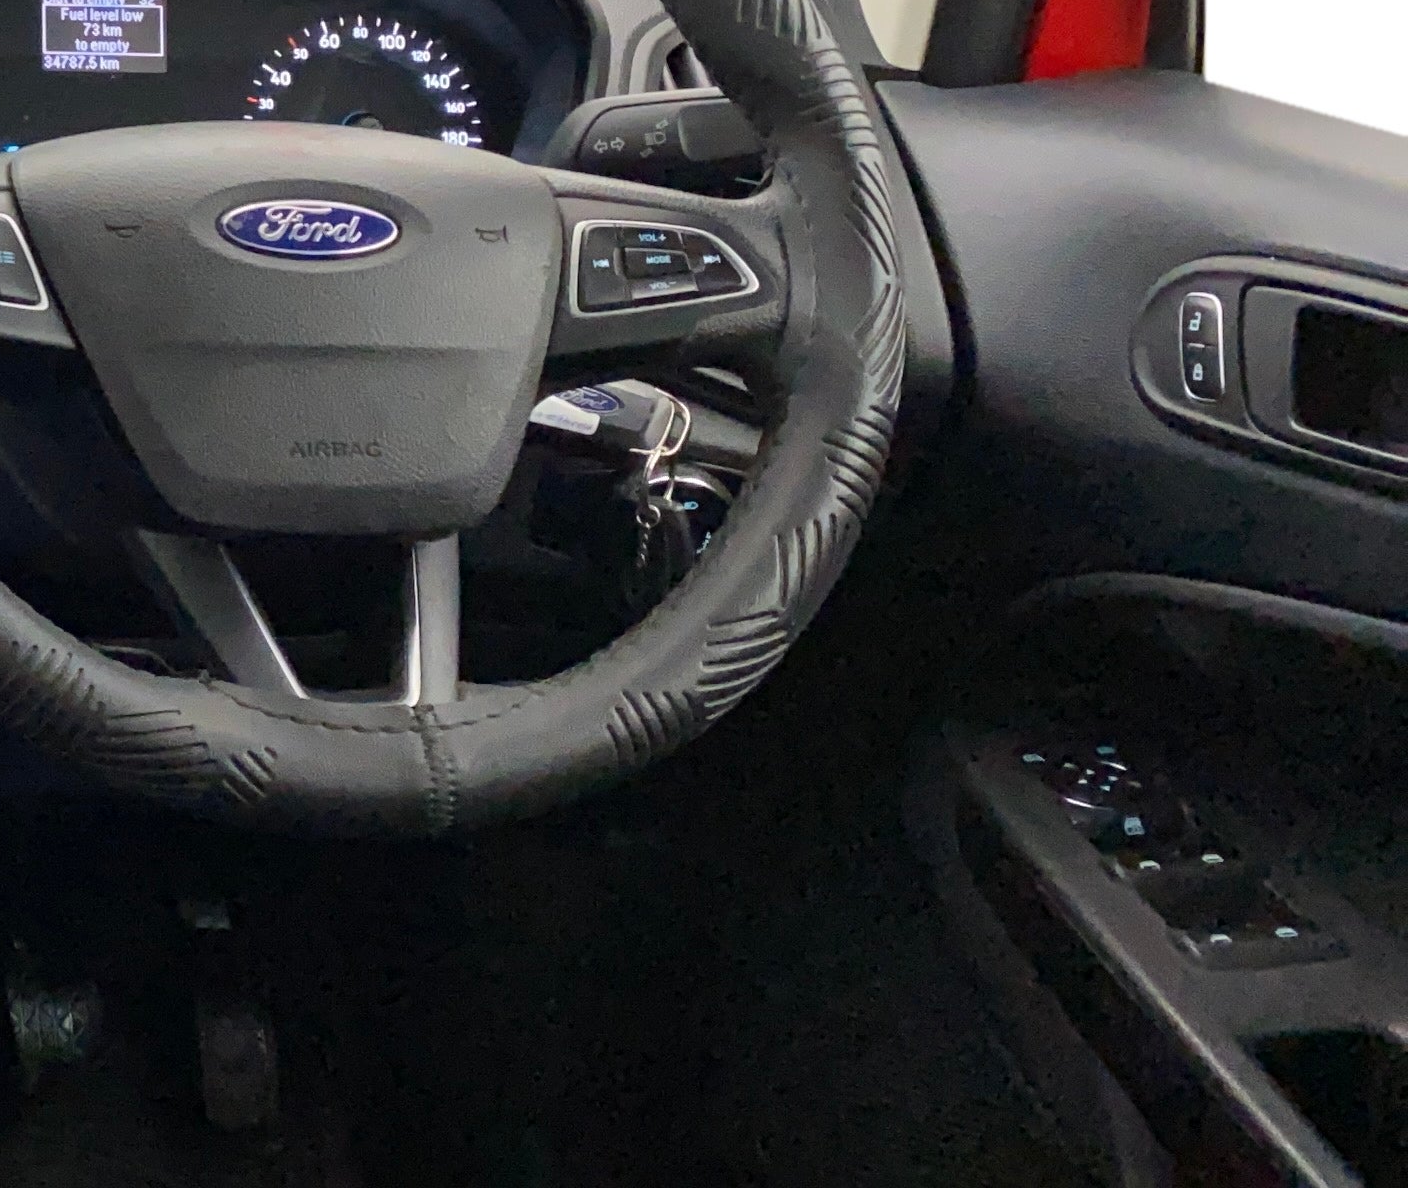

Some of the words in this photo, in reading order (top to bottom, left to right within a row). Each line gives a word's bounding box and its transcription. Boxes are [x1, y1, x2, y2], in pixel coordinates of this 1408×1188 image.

[60, 7, 87, 21] Fuel
[90, 8, 119, 21] level
[122, 9, 144, 22] low
[83, 23, 100, 36] 73
[103, 23, 122, 37] km
[352, 27, 368, 39] 80
[75, 38, 87, 51] to
[90, 40, 130, 53] empty
[319, 34, 340, 49] 60
[378, 35, 405, 50] 100
[292, 48, 309, 60] 50
[411, 50, 431, 62] 120
[44, 55, 97, 69] 34787.5
[100, 55, 120, 70] km
[270, 70, 291, 86] 40
[423, 73, 450, 89] 140
[258, 98, 274, 110] 30
[445, 102, 466, 113] 160
[441, 131, 469, 146] 180
[258, 205, 363, 244] Ford
[646, 255, 672, 264] MODE
[289, 441, 383, 459] AIRBAG
